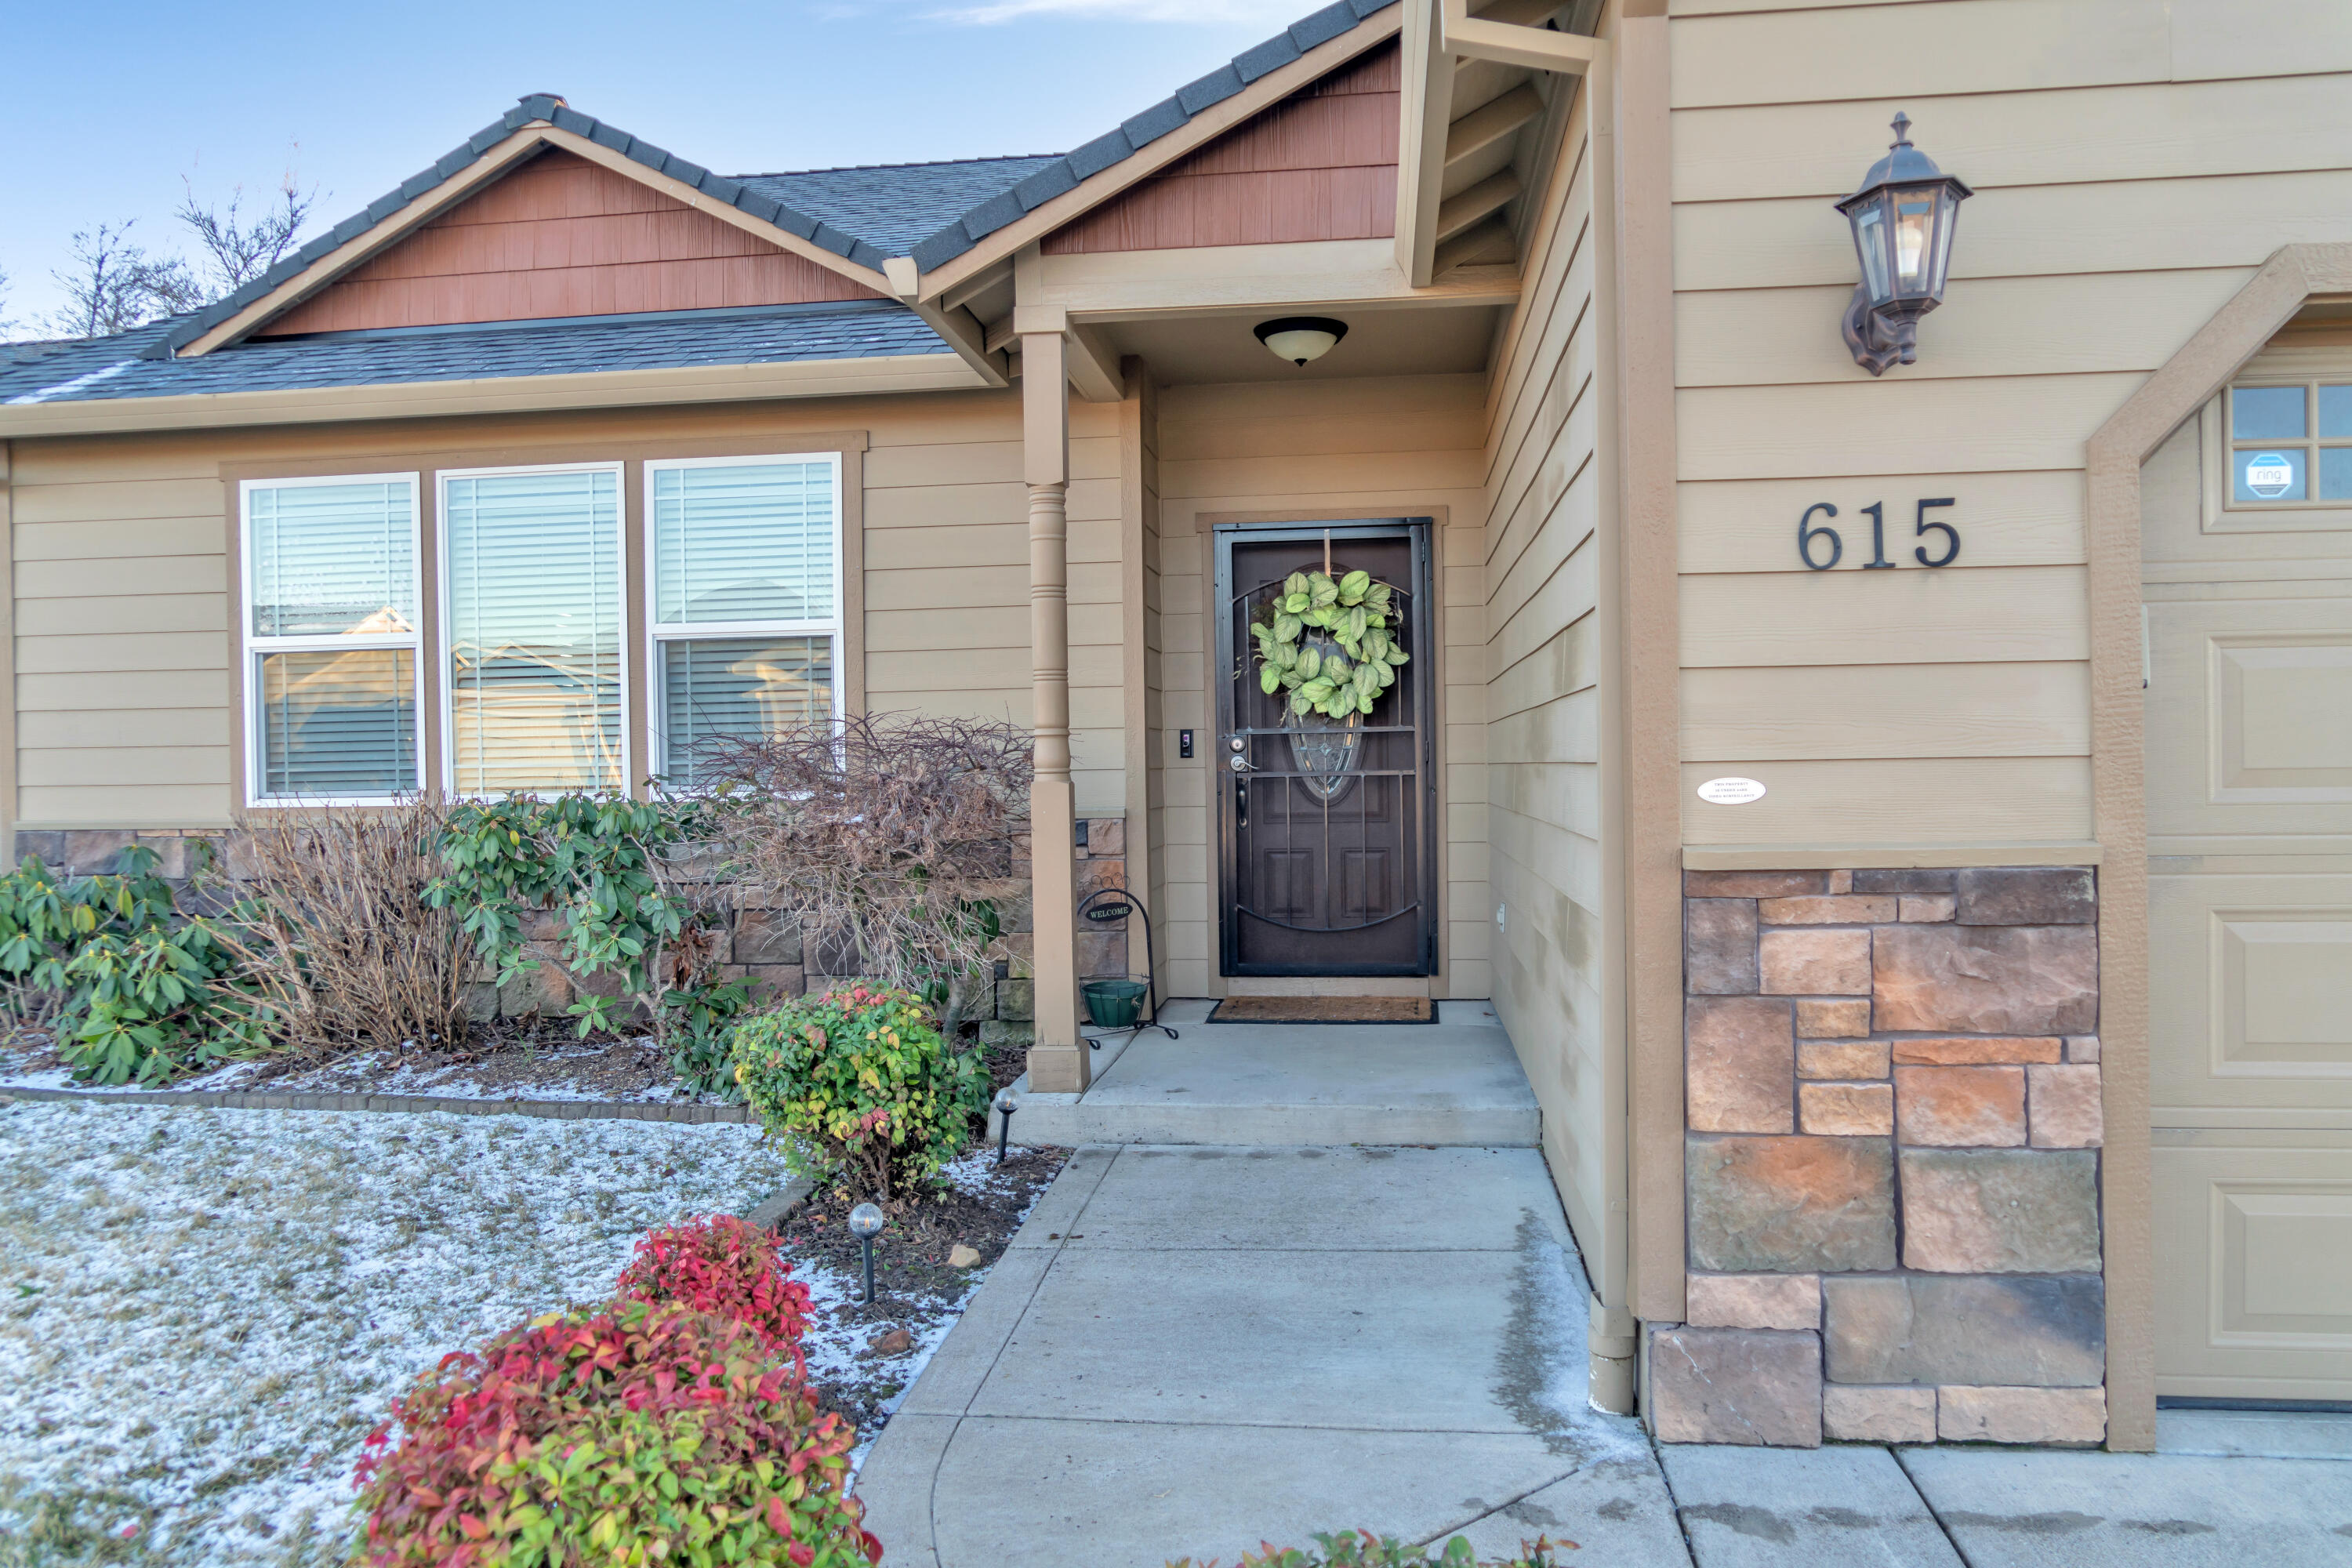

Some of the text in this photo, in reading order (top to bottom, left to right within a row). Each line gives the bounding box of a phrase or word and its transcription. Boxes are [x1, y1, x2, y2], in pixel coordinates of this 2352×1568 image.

[2256, 468, 2282, 483] ring
[1798, 497, 1961, 571] 615
[1091, 906, 1129, 919] WELCOME
